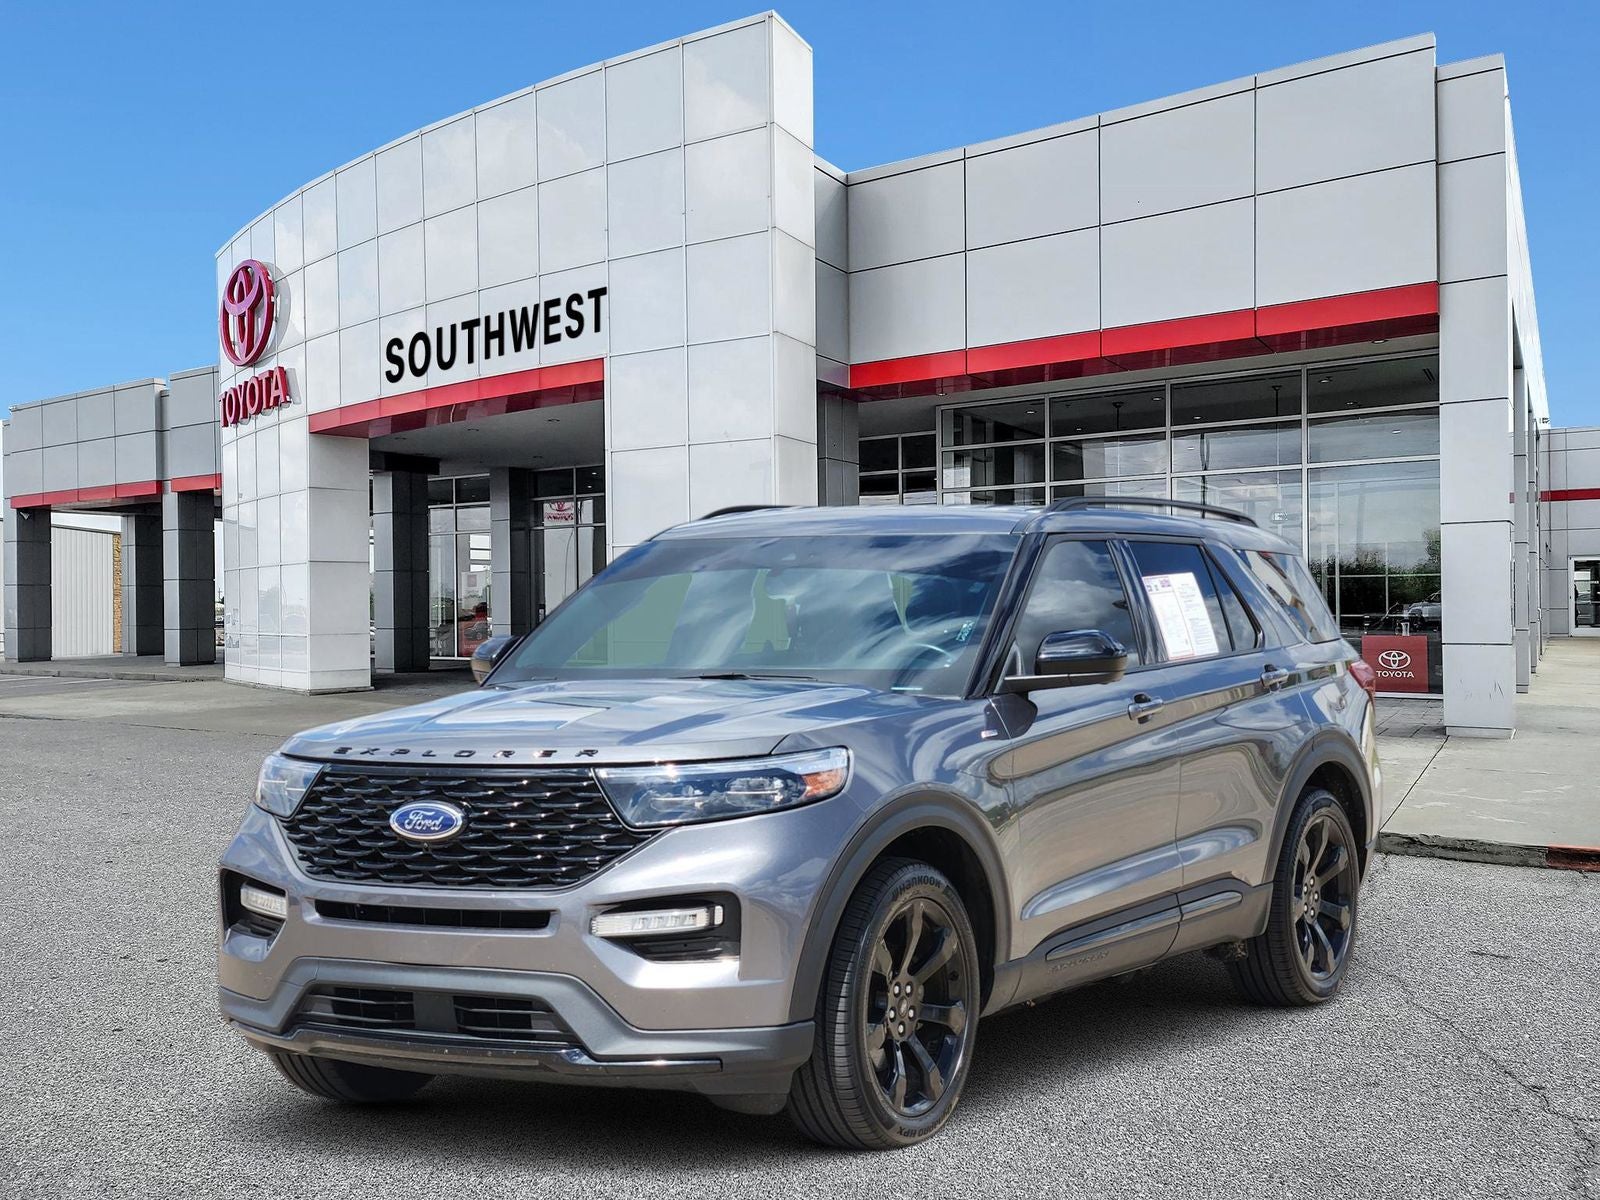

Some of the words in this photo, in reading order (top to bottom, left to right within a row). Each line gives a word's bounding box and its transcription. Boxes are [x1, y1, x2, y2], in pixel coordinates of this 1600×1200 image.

[385, 287, 607, 383] SOUTHWEST
[219, 366, 291, 427] TOYOTA
[1376, 670, 1415, 678] TOYOTA
[333, 746, 599, 758] EXPLORER
[404, 809, 444, 831] Ford
